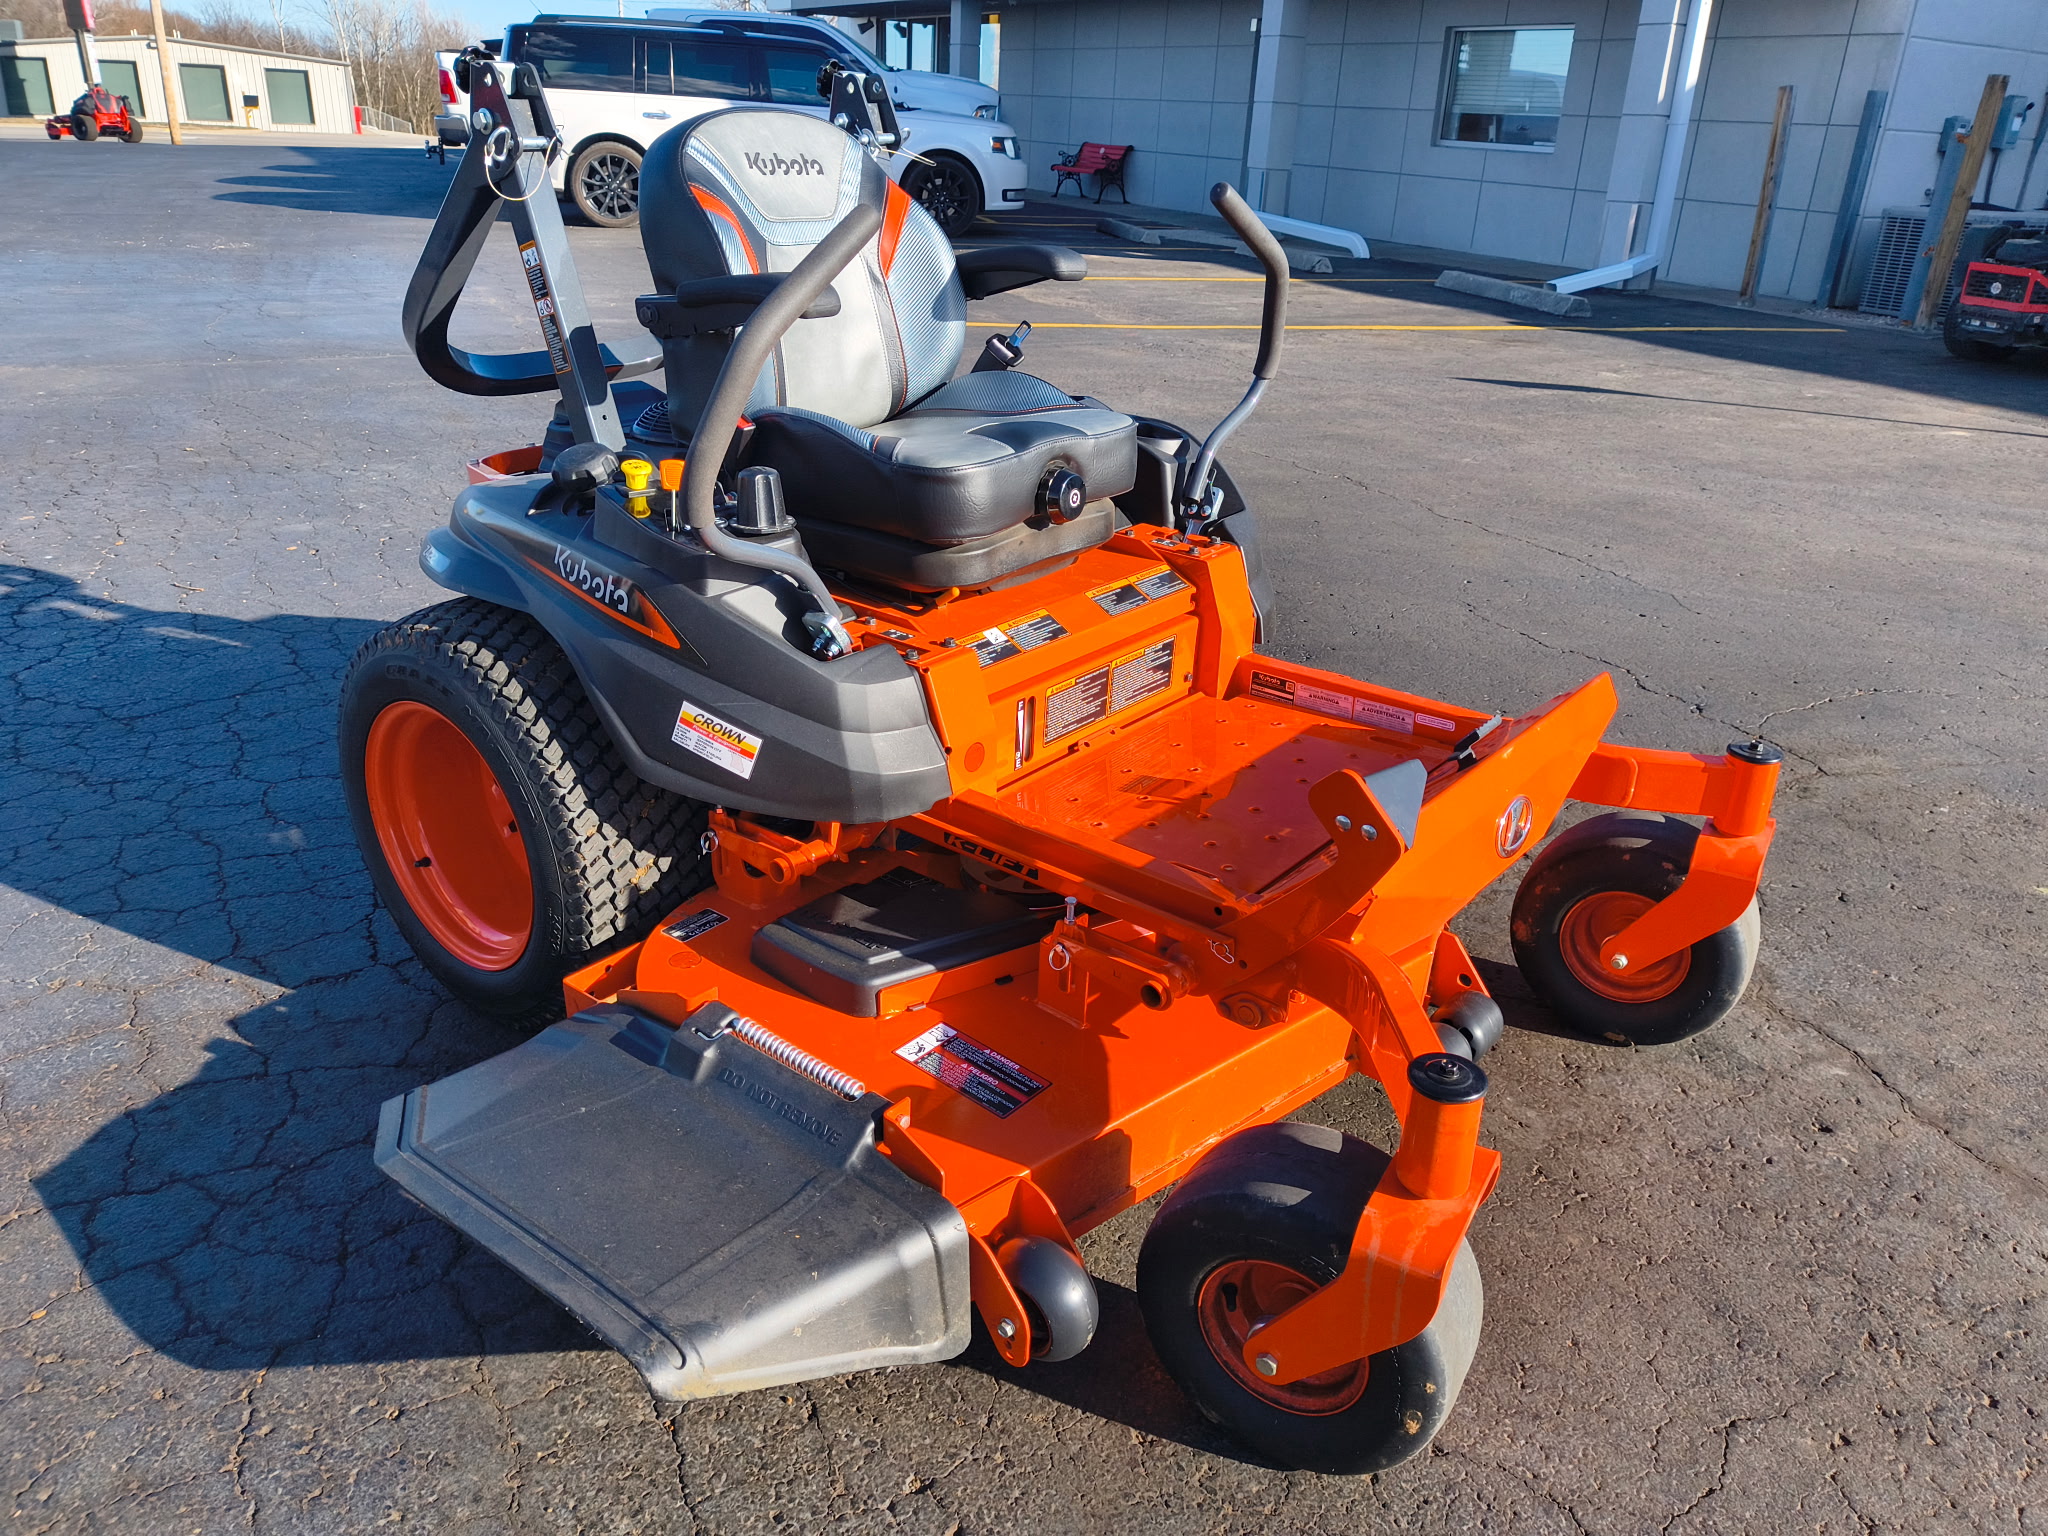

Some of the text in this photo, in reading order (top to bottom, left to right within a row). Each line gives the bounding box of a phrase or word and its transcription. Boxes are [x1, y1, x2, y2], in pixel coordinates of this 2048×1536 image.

[744, 152, 824, 175] Kubota
[554, 543, 629, 613] Kubota
[1313, 694, 1336, 704] WARNING
[1367, 707, 1401, 721] ADVERTENCIA
[692, 725, 709, 736] Power
[713, 735, 742, 752] Equipment
[693, 713, 747, 745] CROWN
[945, 833, 1037, 877] K-LIFT
[990, 1051, 1020, 1070] DANGER
[968, 1066, 999, 1086] PELIGRO
[720, 1067, 843, 1148] DO NOT REMOVE
